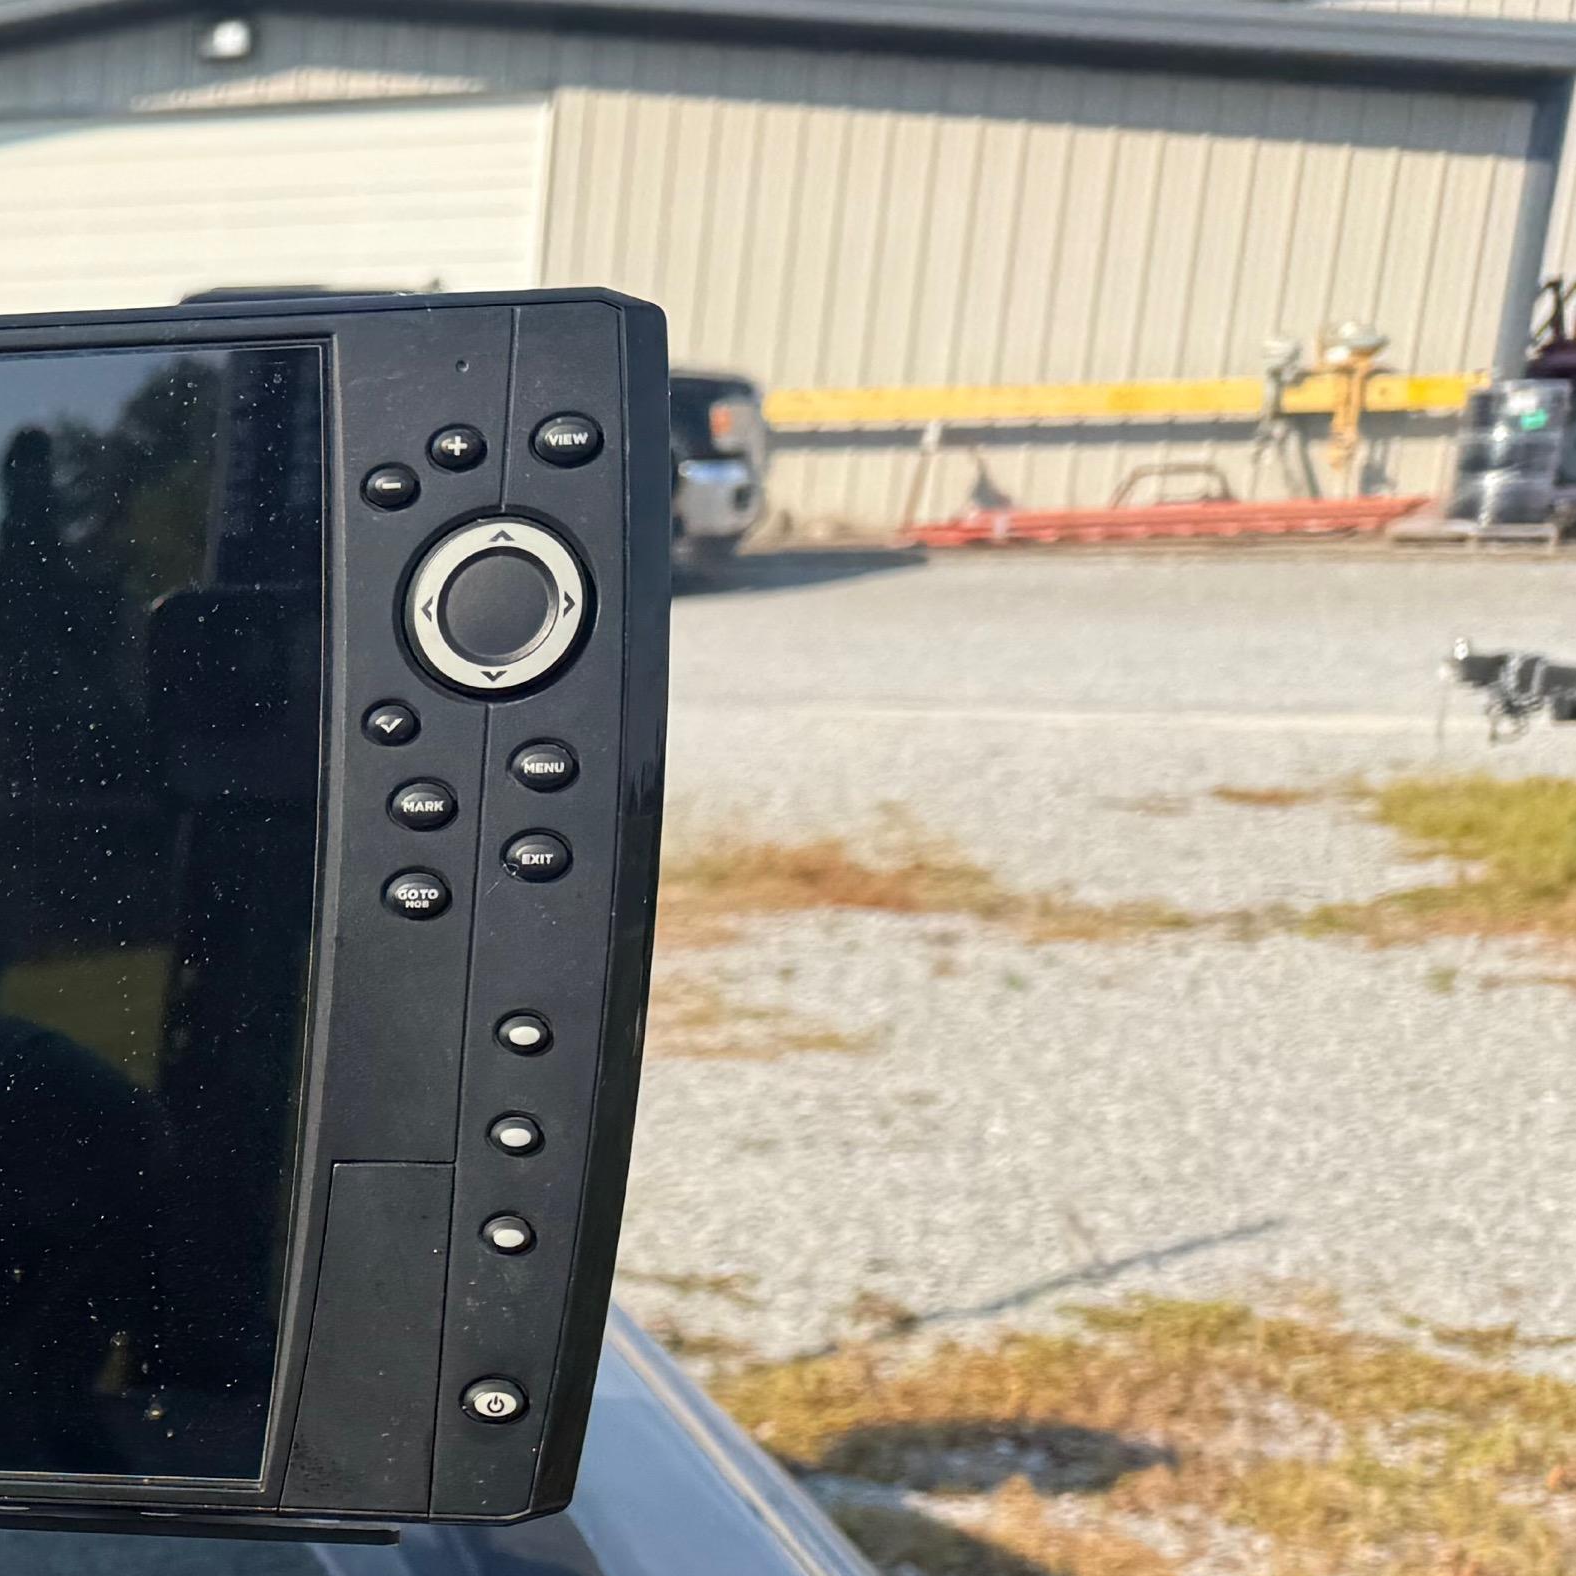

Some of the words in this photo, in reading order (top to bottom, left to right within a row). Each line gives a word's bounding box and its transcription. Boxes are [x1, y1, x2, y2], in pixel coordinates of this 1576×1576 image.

[548, 431, 589, 447] VIEW
[523, 761, 565, 775] MENU
[402, 800, 444, 813] MARK
[521, 853, 554, 865] EXIT
